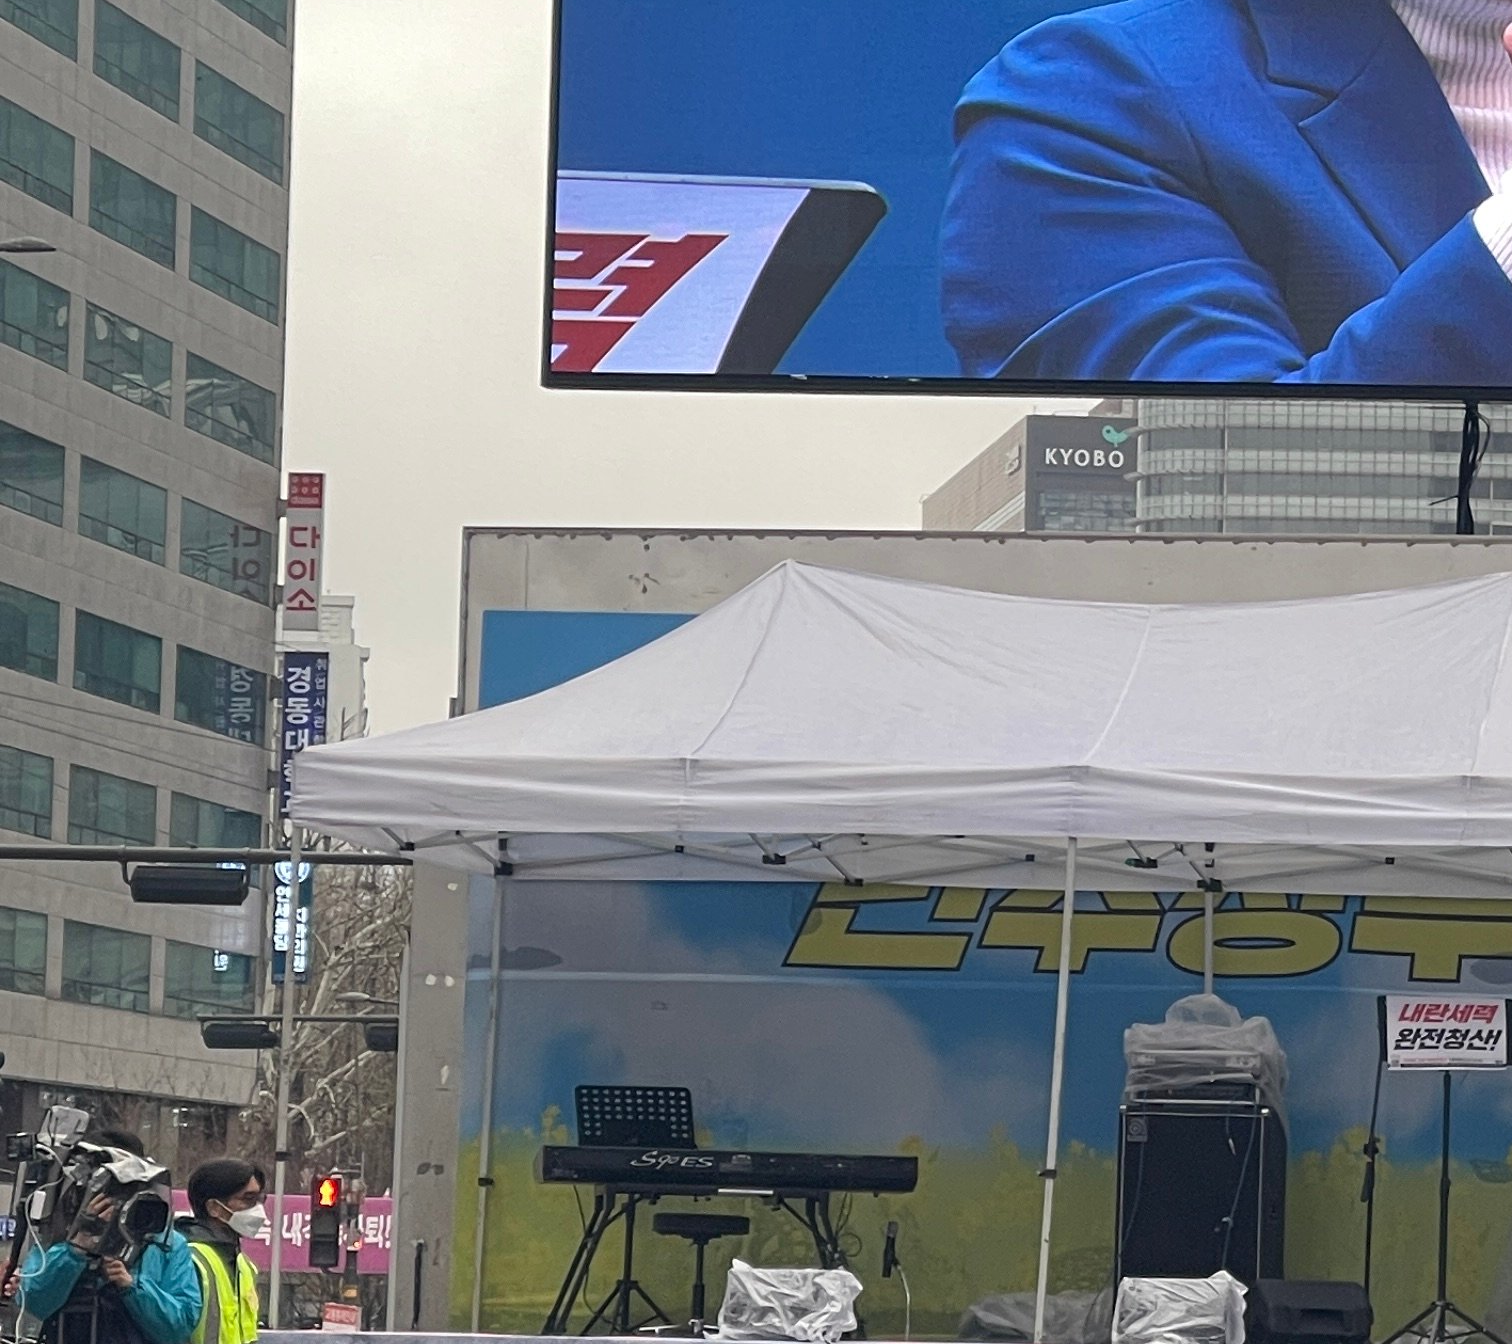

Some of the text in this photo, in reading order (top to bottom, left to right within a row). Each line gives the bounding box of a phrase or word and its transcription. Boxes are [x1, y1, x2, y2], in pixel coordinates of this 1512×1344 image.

[1045, 448, 1124, 468] KYOBO
[286, 526, 320, 611] 다이소
[281, 666, 312, 813] 경동대
[1398, 1003, 1499, 1024] 내란세력
[1394, 1028, 1503, 1052] 완전청산!
